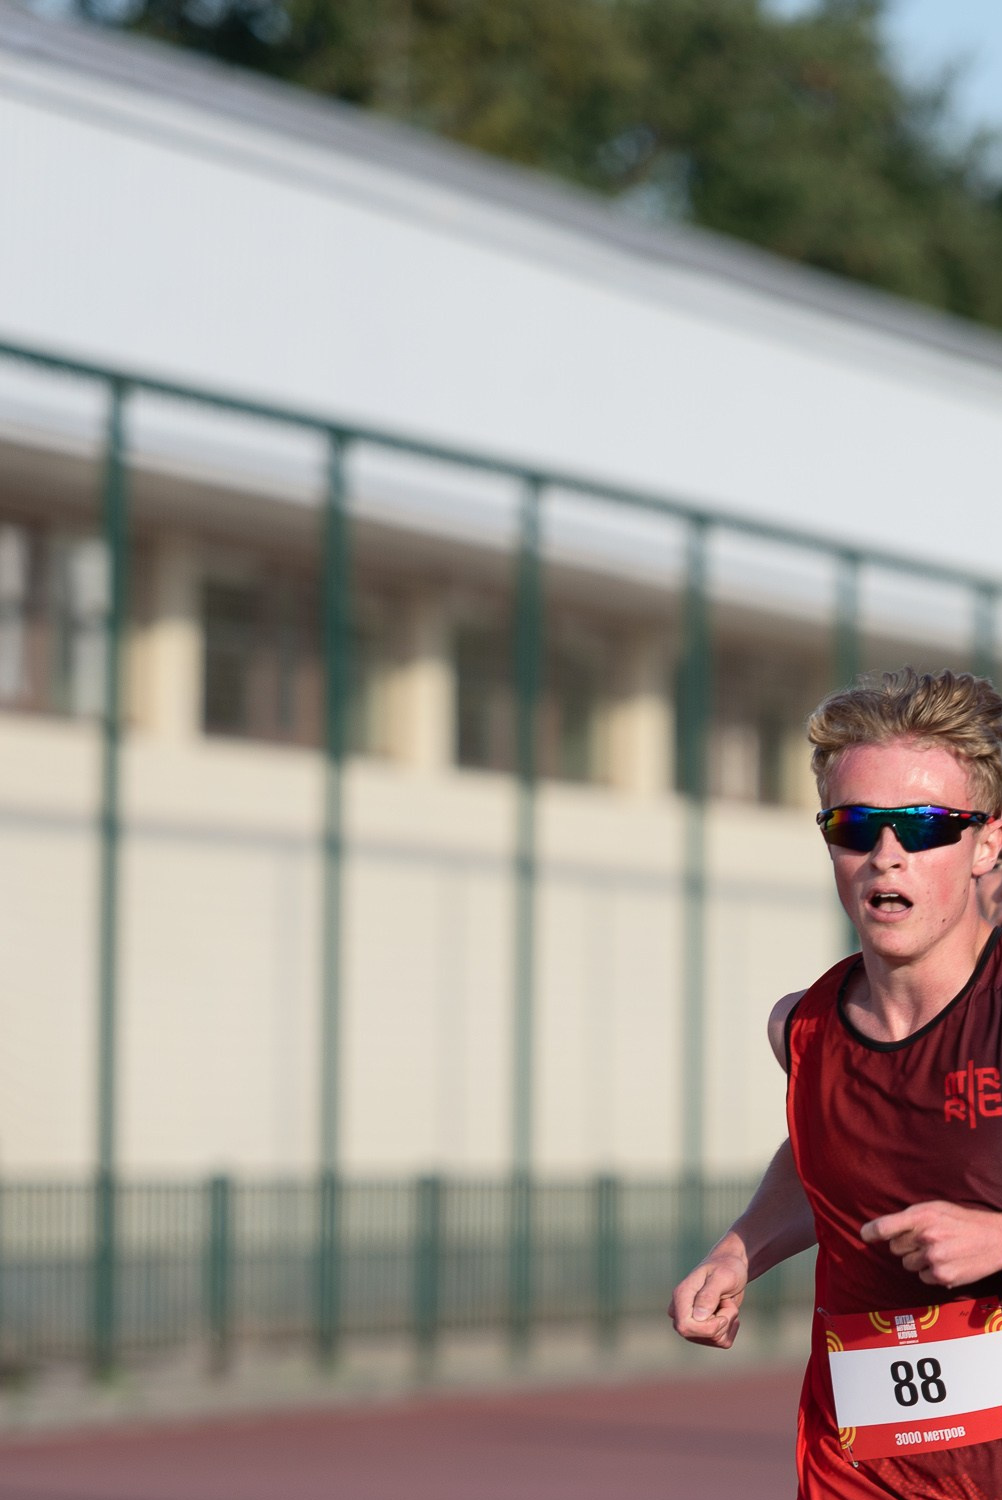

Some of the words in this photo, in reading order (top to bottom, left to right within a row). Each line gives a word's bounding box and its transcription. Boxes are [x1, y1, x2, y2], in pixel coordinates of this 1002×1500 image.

[890, 1357, 947, 1407] 88
[895, 1431, 922, 1445] 3000
[923, 1426, 966, 1441] метров
